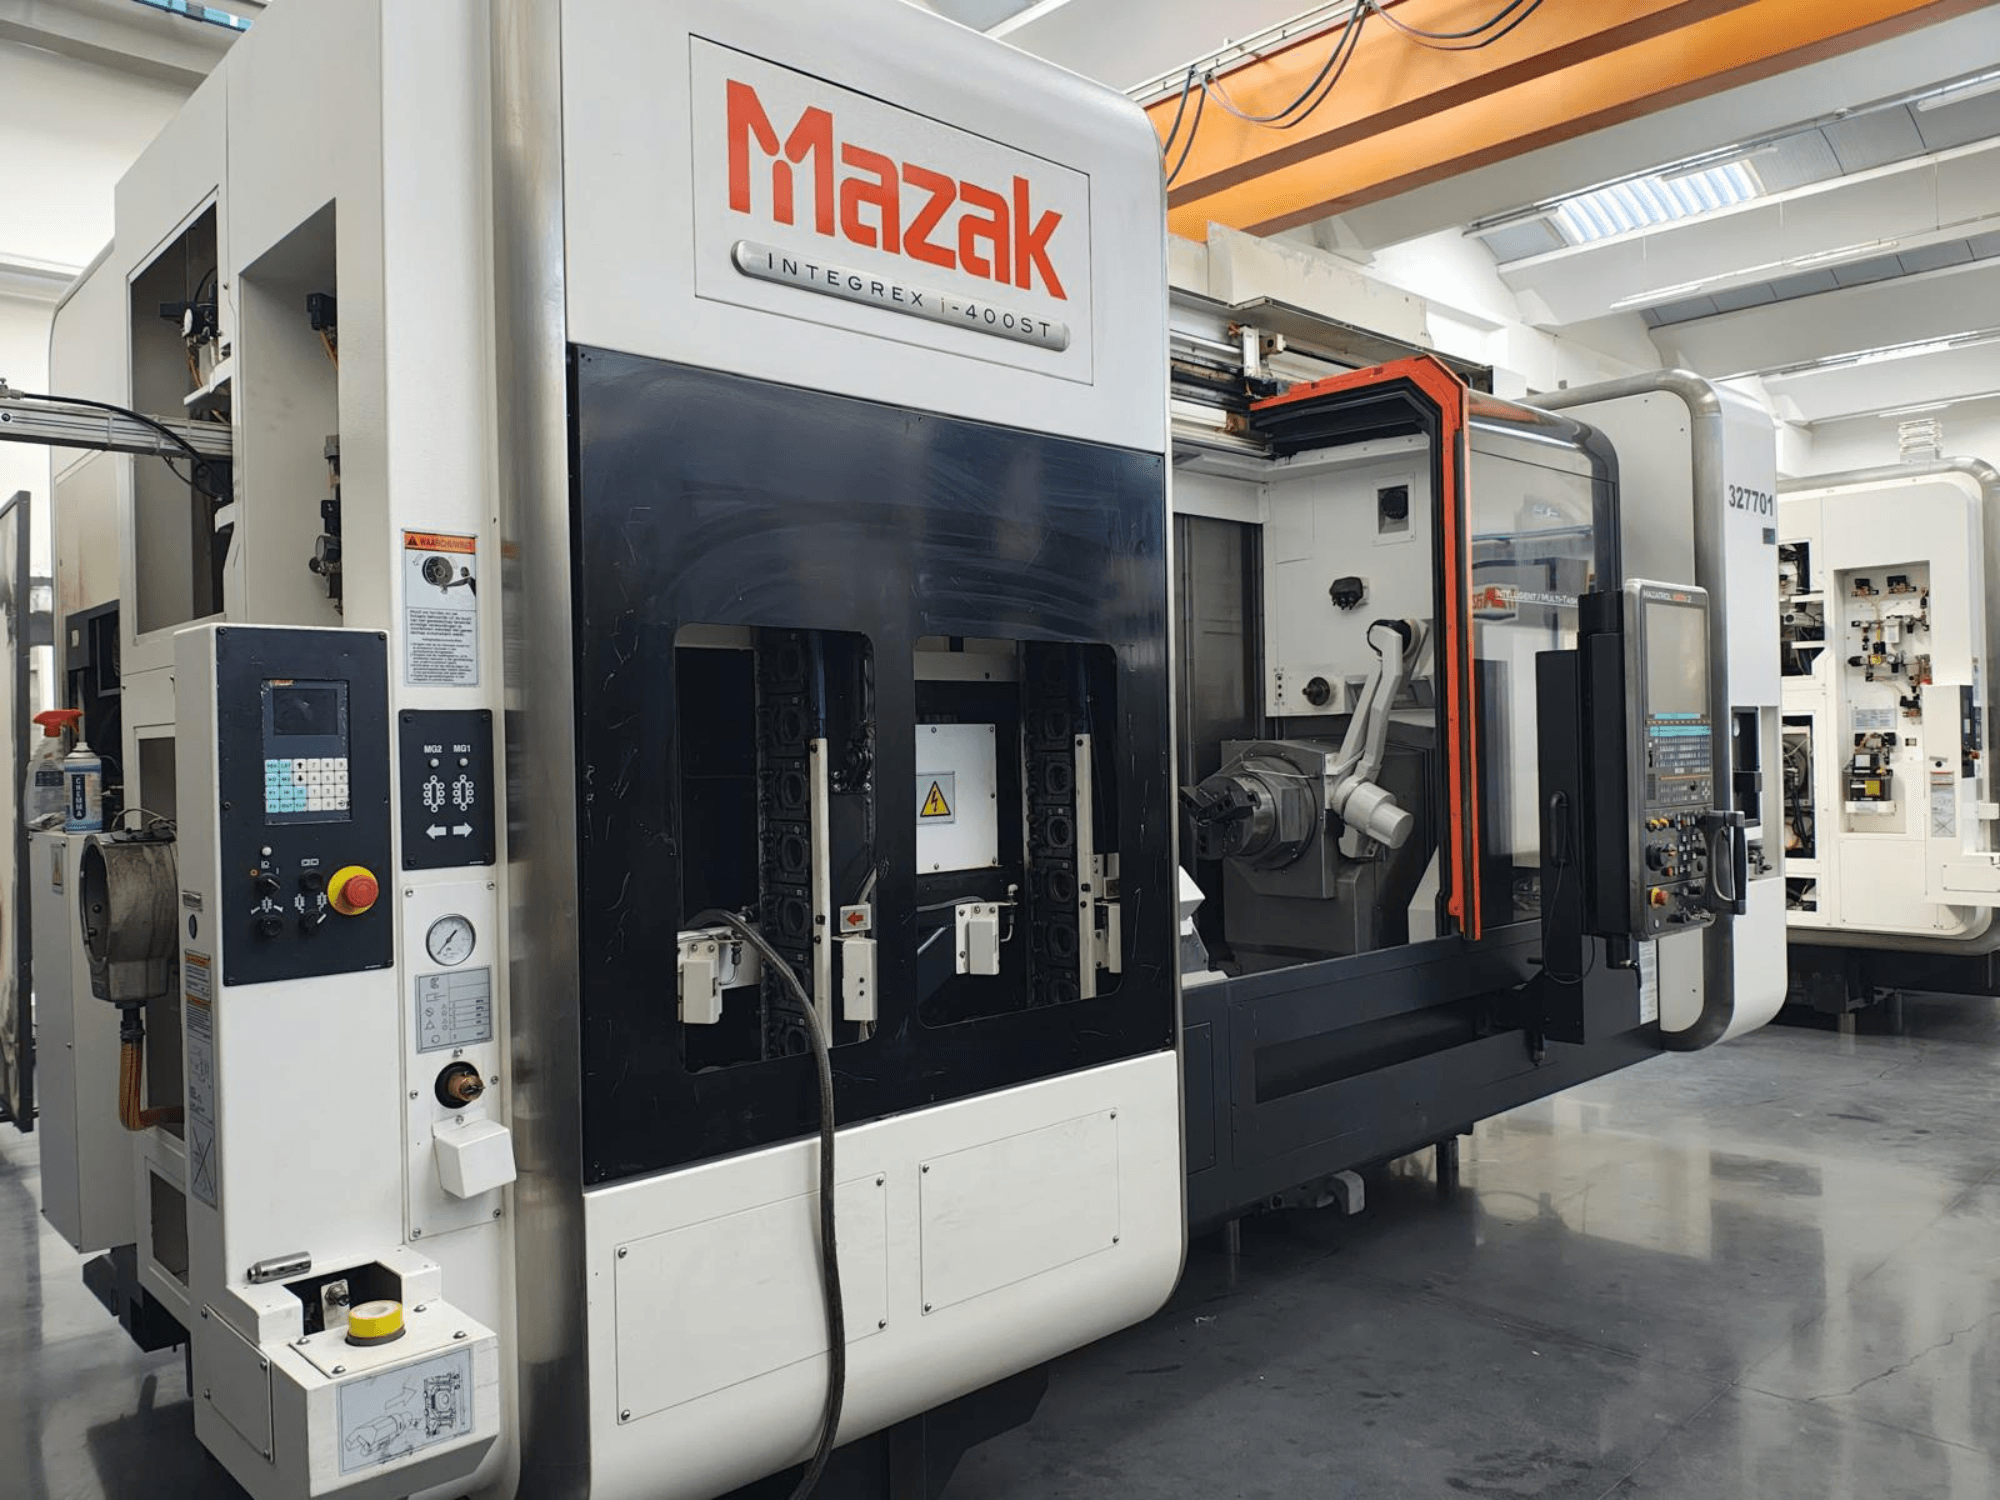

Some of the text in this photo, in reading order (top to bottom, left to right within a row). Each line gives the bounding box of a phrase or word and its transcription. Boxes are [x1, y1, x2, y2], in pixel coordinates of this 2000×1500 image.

[726, 78, 1068, 301] Mazak
[768, 252, 1051, 338] INTEGREX i-400ST
[1728, 484, 1774, 517] 327701
[423, 744, 471, 754] MG2 MG1
